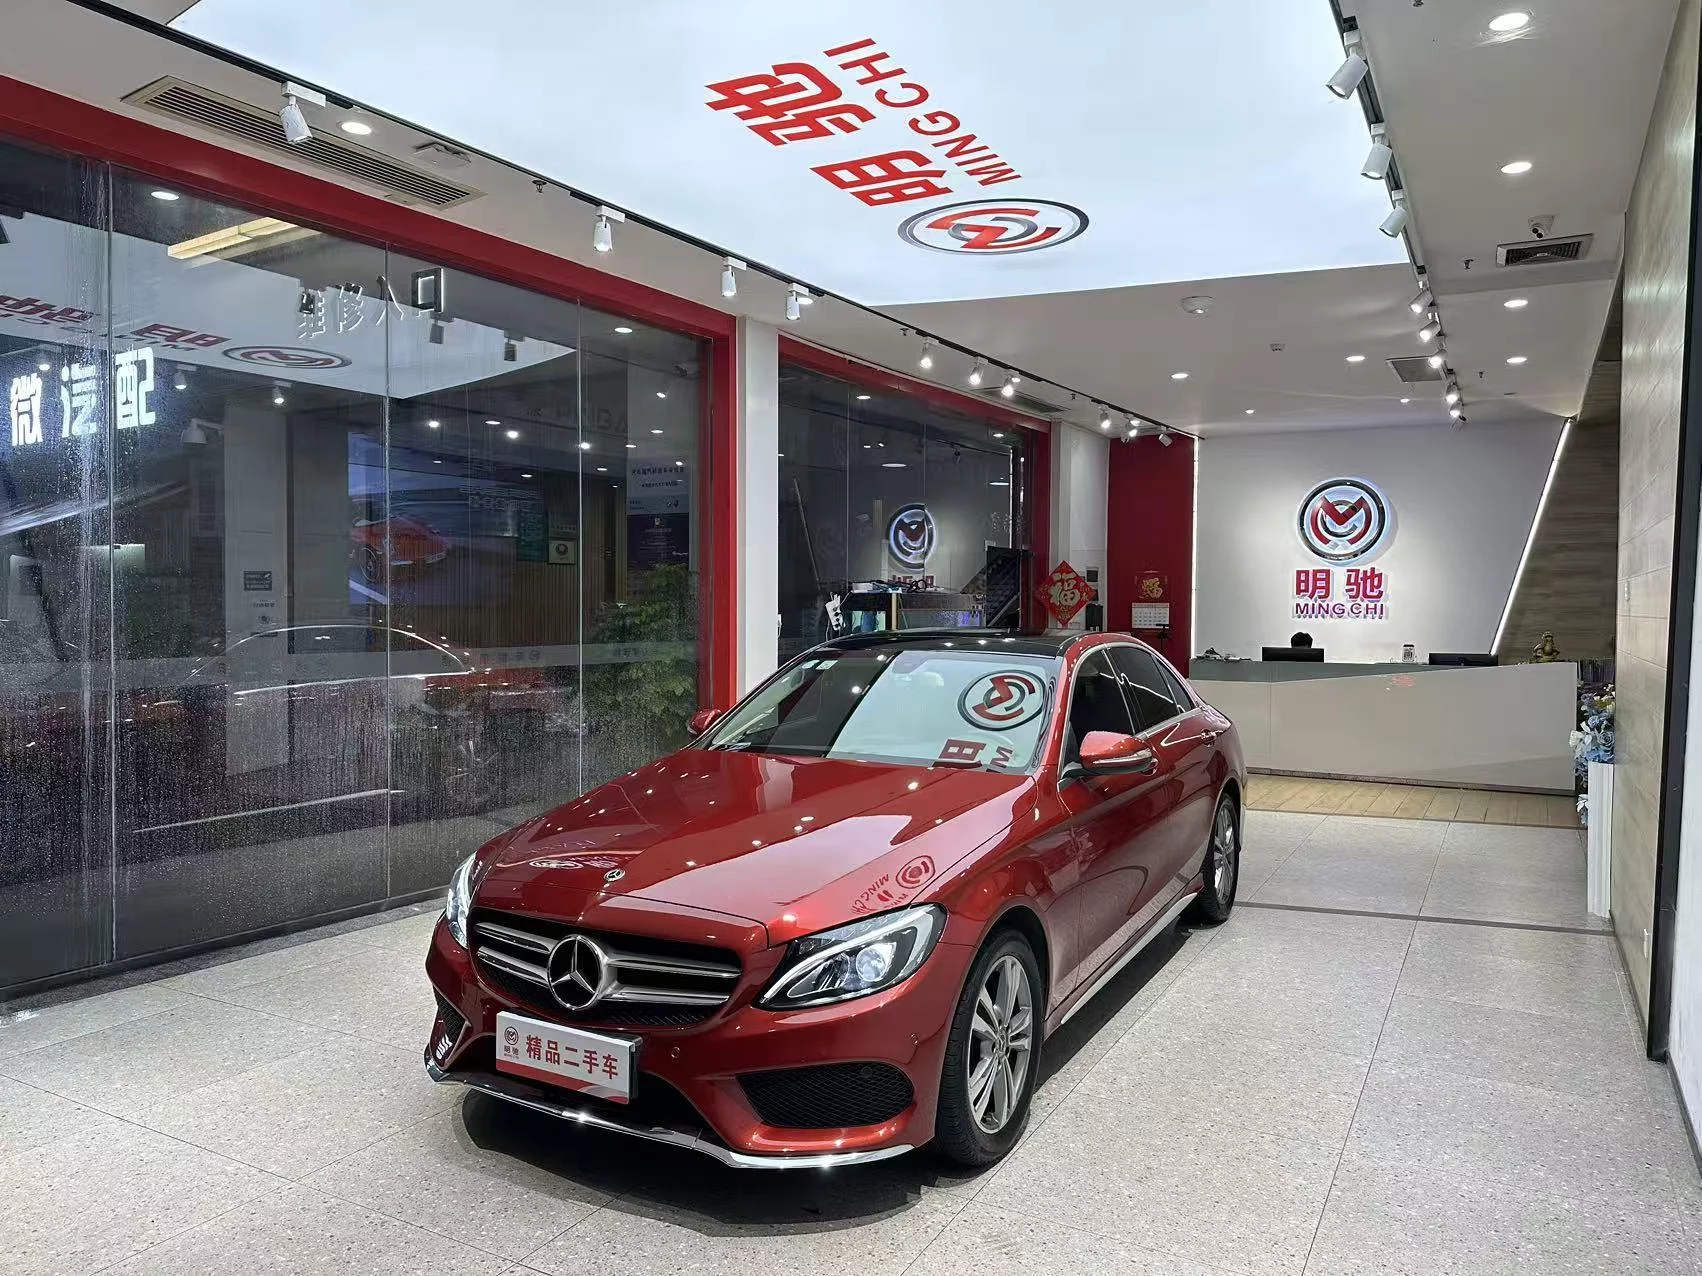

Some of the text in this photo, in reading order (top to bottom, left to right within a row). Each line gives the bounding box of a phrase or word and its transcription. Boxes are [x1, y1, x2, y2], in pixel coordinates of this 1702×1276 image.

[704, 62, 954, 206] 明驰
[298, 267, 444, 339] 维修入口
[1047, 572, 1081, 607] 福
[1295, 567, 1384, 600] 明驰
[525, 1034, 619, 1080] 精品二手车
